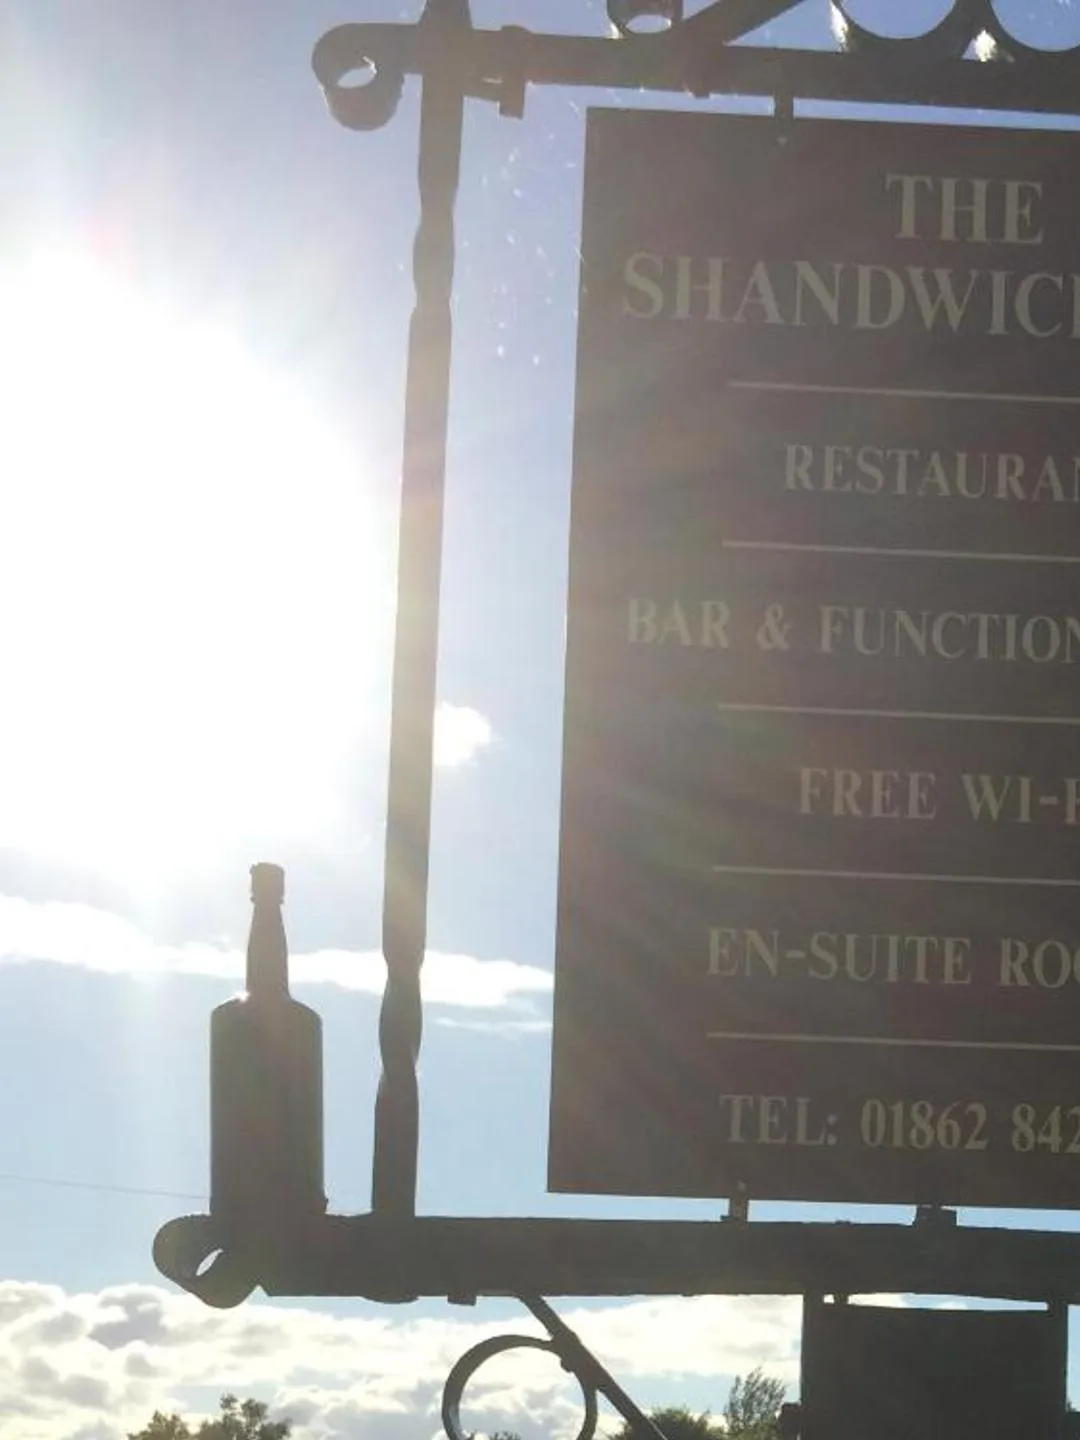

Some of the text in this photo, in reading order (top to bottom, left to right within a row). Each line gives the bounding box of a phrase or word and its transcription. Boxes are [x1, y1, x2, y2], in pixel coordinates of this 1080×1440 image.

[885, 173, 1043, 245] THE
[626, 597, 730, 649] BAR
[756, 603, 792, 652] &
[800, 766, 937, 820] FREE
[706, 926, 972, 985] EN-SUITE
[720, 1093, 839, 1147] TEL:
[860, 1098, 989, 1151] 01862
